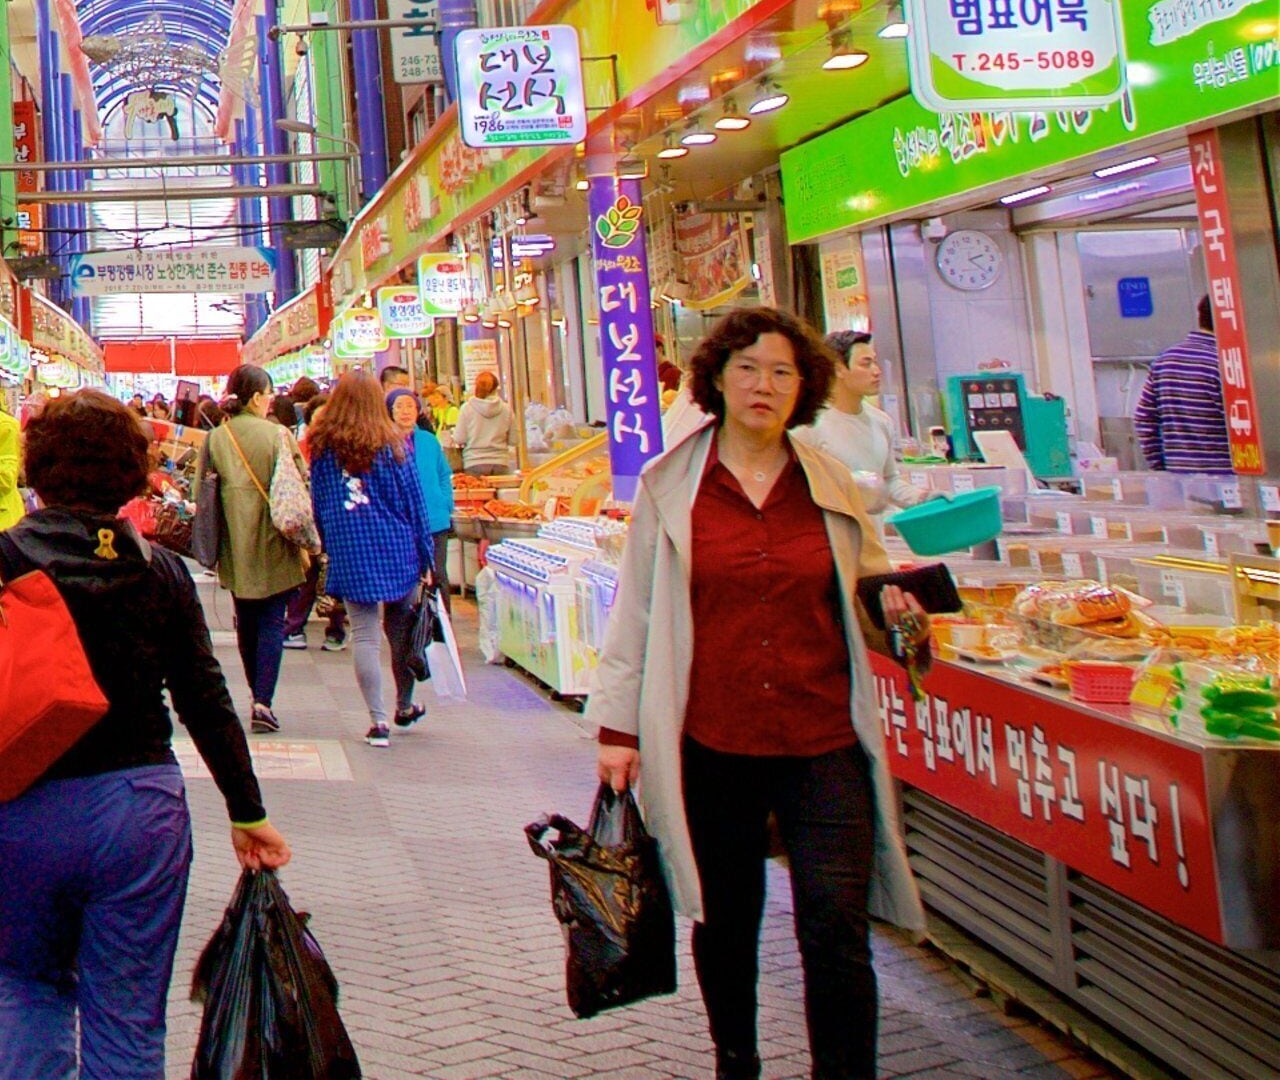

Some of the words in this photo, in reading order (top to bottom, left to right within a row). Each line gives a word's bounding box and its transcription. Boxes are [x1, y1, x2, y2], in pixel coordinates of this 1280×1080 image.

[479, 45, 555, 75] 대보
[952, 50, 1095, 72] T.245-5089
[479, 78, 566, 115] 선식
[474, 120, 505, 134] 1986
[600, 280, 649, 455] 대보선식
[1005, 723, 1085, 822] 멈추고
